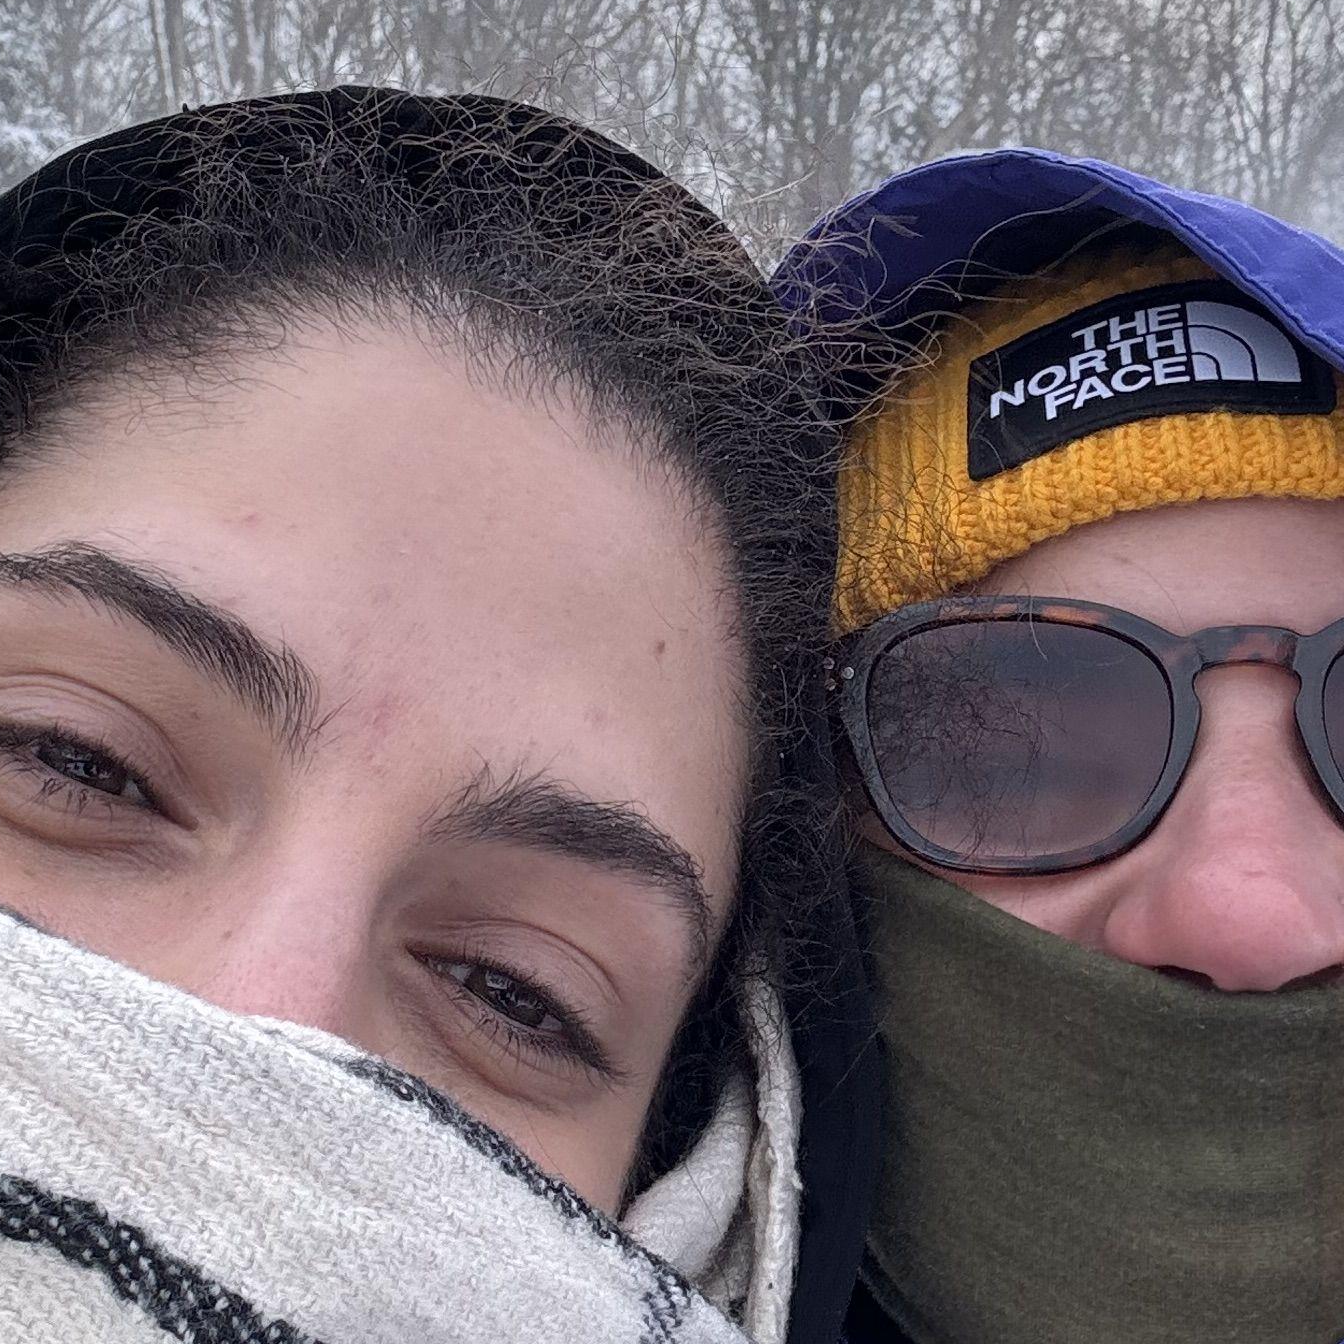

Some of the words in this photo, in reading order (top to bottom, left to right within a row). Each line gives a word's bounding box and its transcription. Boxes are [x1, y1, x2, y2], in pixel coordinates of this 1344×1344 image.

[1071, 304, 1183, 351] THE
[990, 330, 1186, 418] NORTH
[1044, 356, 1190, 420] FACE
